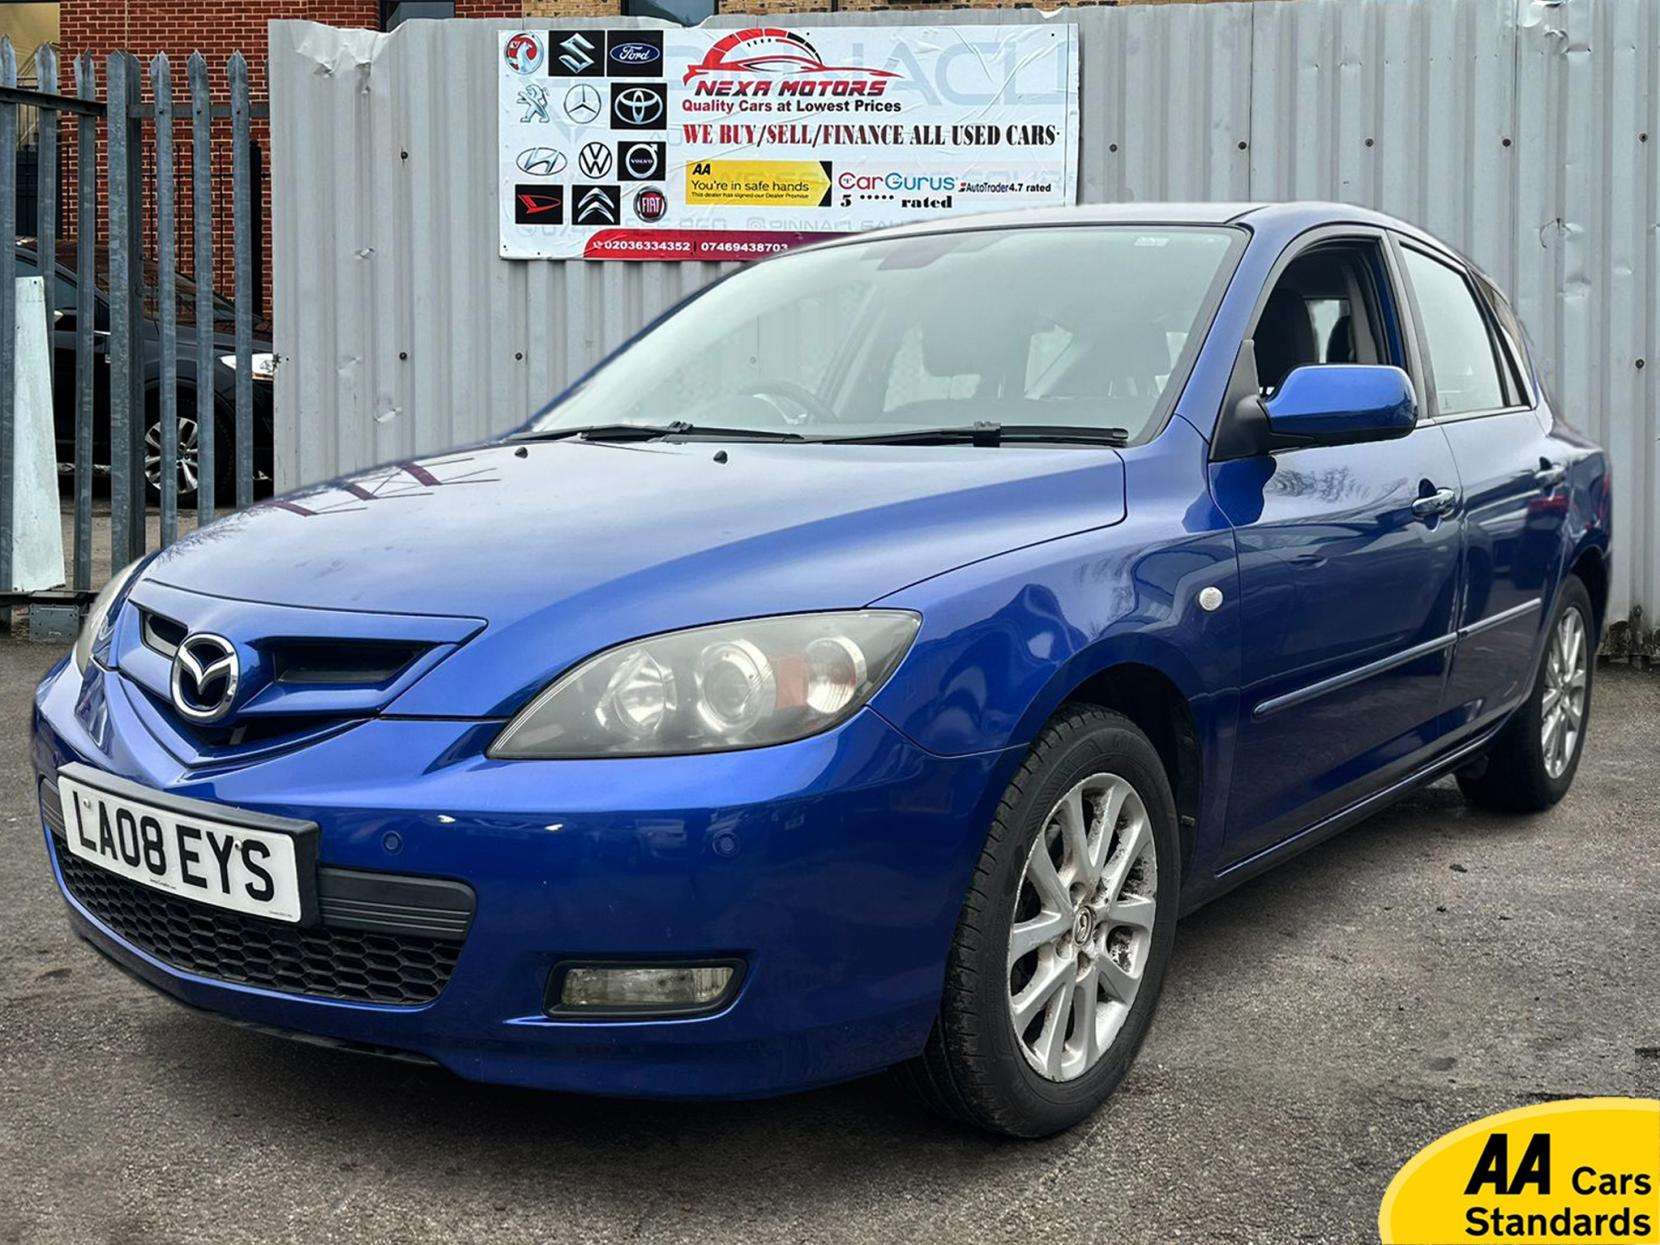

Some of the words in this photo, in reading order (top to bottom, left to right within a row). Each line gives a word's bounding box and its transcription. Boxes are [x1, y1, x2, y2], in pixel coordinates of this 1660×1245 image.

[619, 46, 650, 60] Ford
[694, 80, 773, 97] NEXA
[777, 80, 888, 97] MOTORS
[682, 99, 734, 115] Quality
[738, 99, 773, 112] Cars
[776, 100, 792, 112] at
[796, 100, 850, 112] Lowest
[854, 100, 902, 113] Prices
[682, 124, 713, 144] WE
[719, 124, 904, 148] BUY/SELL/FINANCE
[909, 125, 946, 146] ALL
[951, 125, 1001, 146] USED
[1005, 125, 1056, 146] CARS
[692, 163, 711, 175] AA
[691, 180, 728, 191] You're
[730, 181, 742, 191] in
[744, 181, 770, 192] safe
[772, 181, 810, 192] hands
[838, 172, 955, 191] CarGurus
[1025, 183, 1052, 193] rated
[641, 197, 662, 213] FIAT
[840, 194, 852, 208] 5
[901, 195, 953, 209] rated
[604, 240, 691, 251] 02036334352
[72, 790, 167, 877] LA08
[175, 823, 275, 902] EYS
